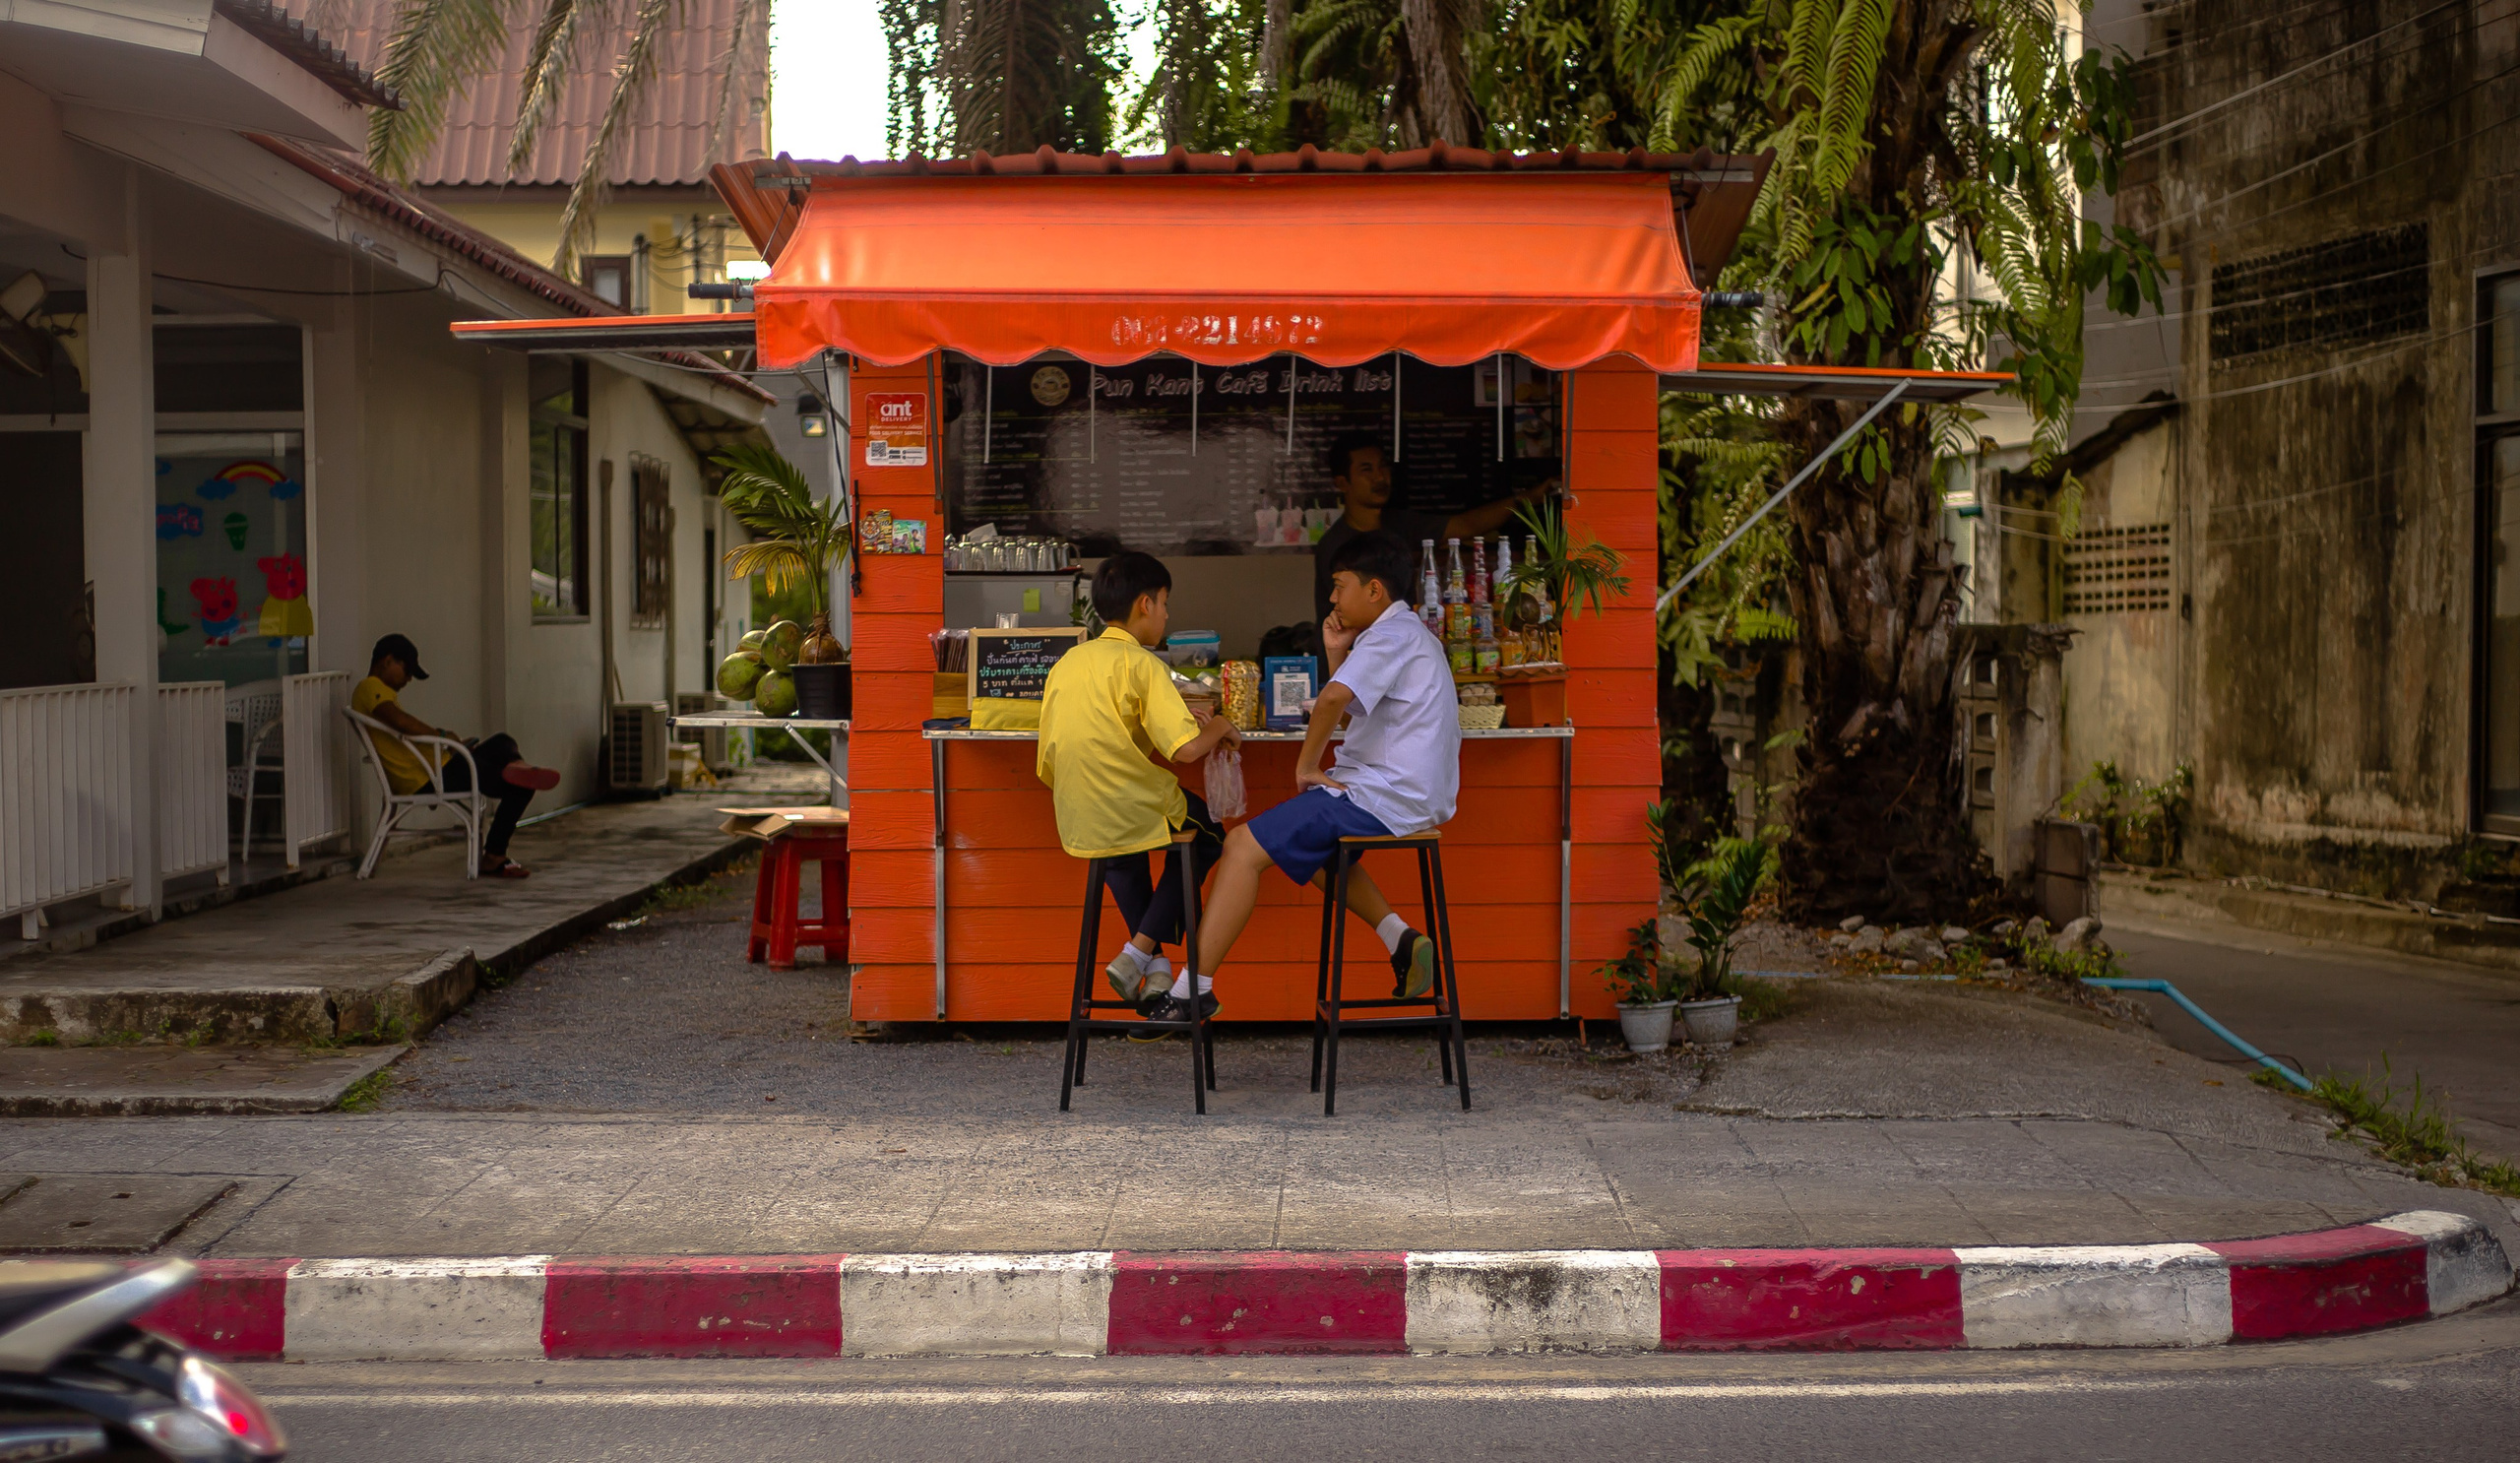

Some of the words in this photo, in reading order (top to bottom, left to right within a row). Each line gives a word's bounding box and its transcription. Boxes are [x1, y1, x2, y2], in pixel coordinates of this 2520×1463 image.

[1087, 372, 1135, 399] Pun
[1278, 369, 1345, 393] Drink
[1354, 367, 1393, 392] list
[879, 400, 913, 416] ant
